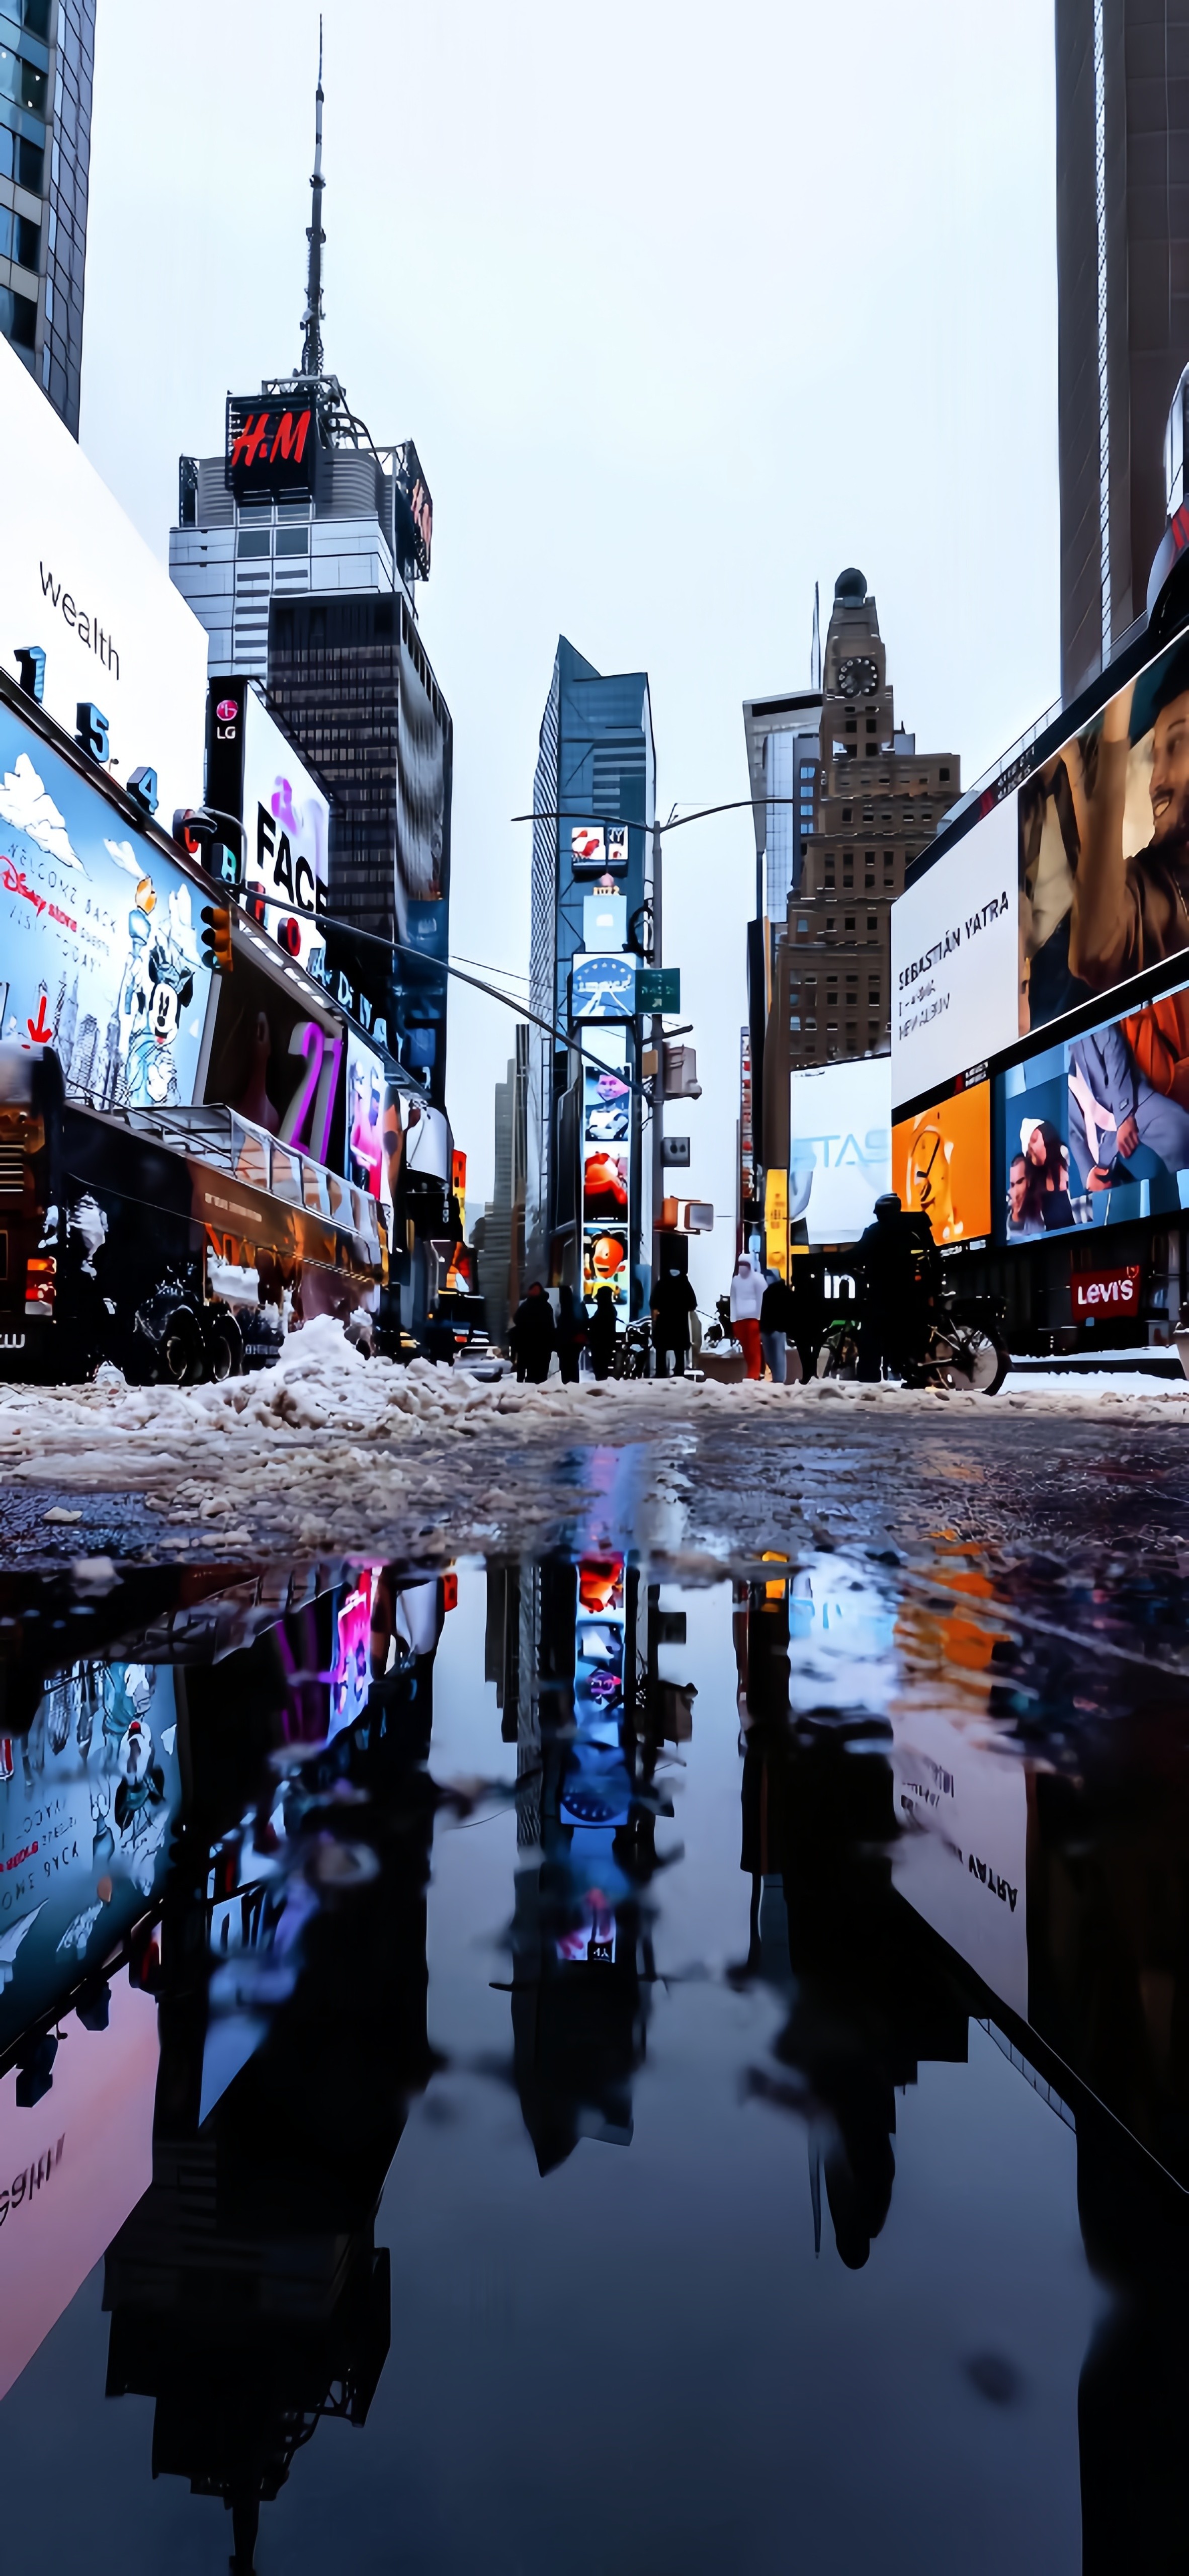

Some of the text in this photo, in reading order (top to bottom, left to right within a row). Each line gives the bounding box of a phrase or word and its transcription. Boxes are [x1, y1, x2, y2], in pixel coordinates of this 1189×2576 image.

[40, 560, 119, 680] wealth
[217, 726, 236, 739] LG
[965, 891, 1009, 939] YATRA
[289, 1021, 344, 1164] 21
